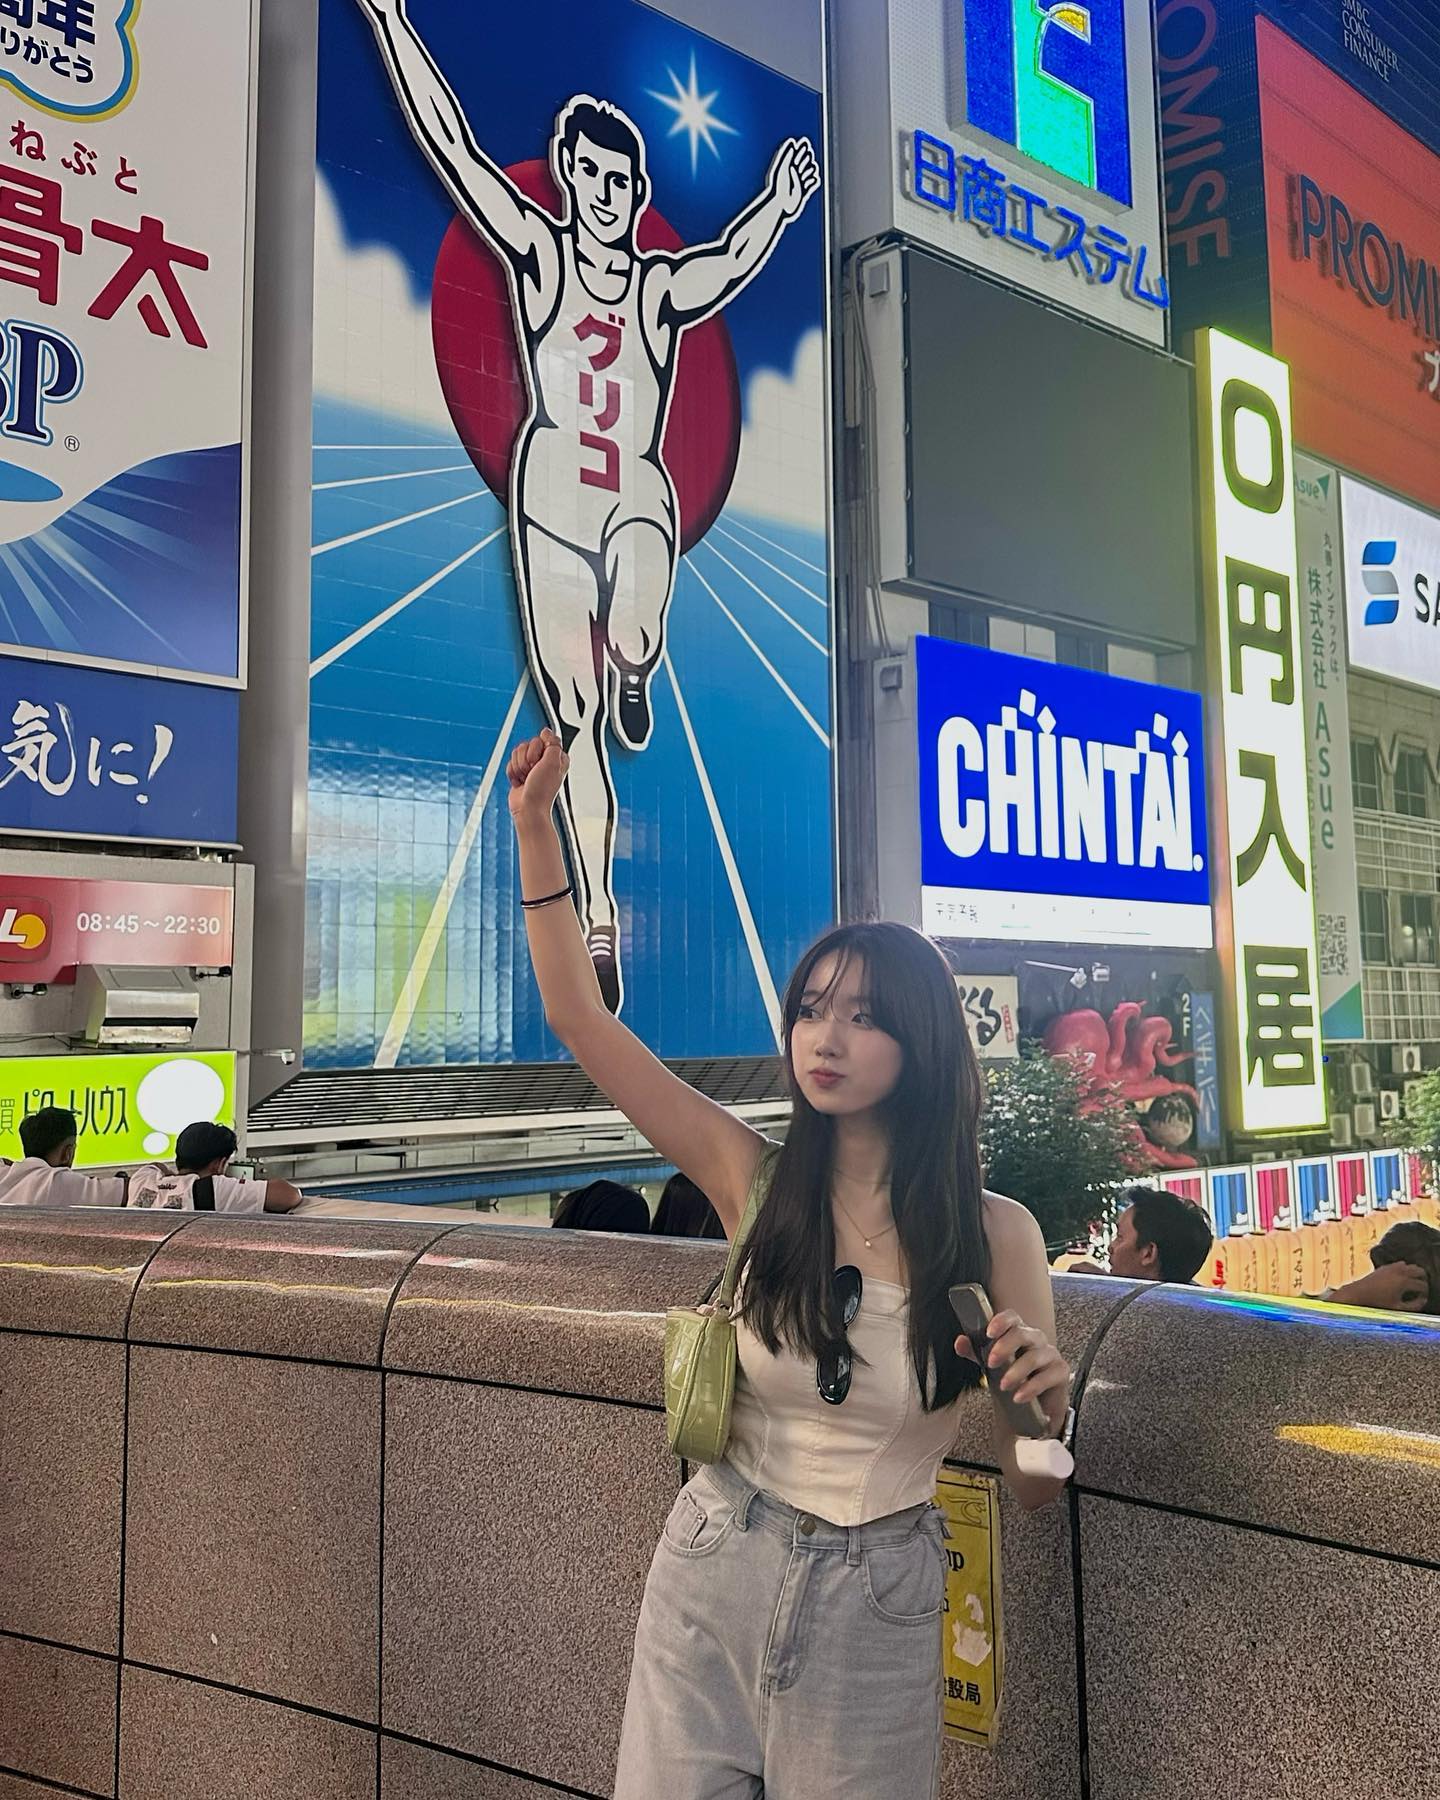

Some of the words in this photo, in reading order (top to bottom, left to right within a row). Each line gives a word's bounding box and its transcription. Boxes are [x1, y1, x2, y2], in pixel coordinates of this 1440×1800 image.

[0, 25, 94, 84] りがとう
[1342, 9, 1400, 73] CONSUMER
[1343, 29, 1389, 82] FINANCE
[913, 128, 1170, 310] 日商エステム
[572, 312, 626, 494] グリコ
[943, 1676, 981, 1706] 設局
